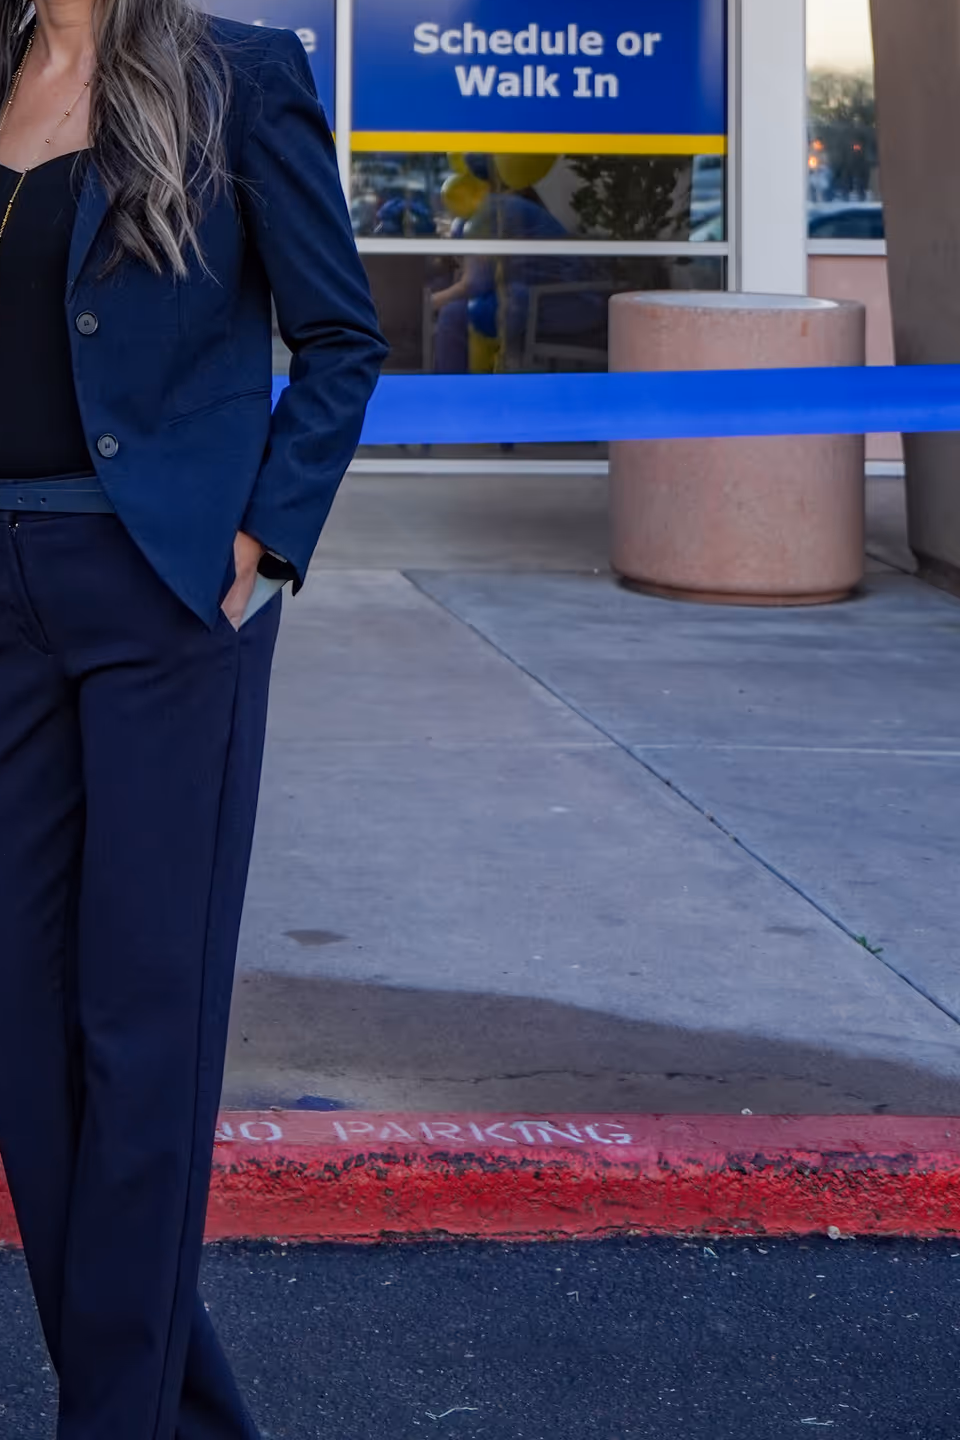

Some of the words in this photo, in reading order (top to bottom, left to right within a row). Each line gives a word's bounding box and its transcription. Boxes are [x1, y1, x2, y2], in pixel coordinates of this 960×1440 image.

[413, 22, 604, 56] Schedule
[616, 31, 662, 57] or
[454, 65, 560, 97] Walk
[572, 66, 619, 98] In
[333, 1120, 634, 1145] PARKING
